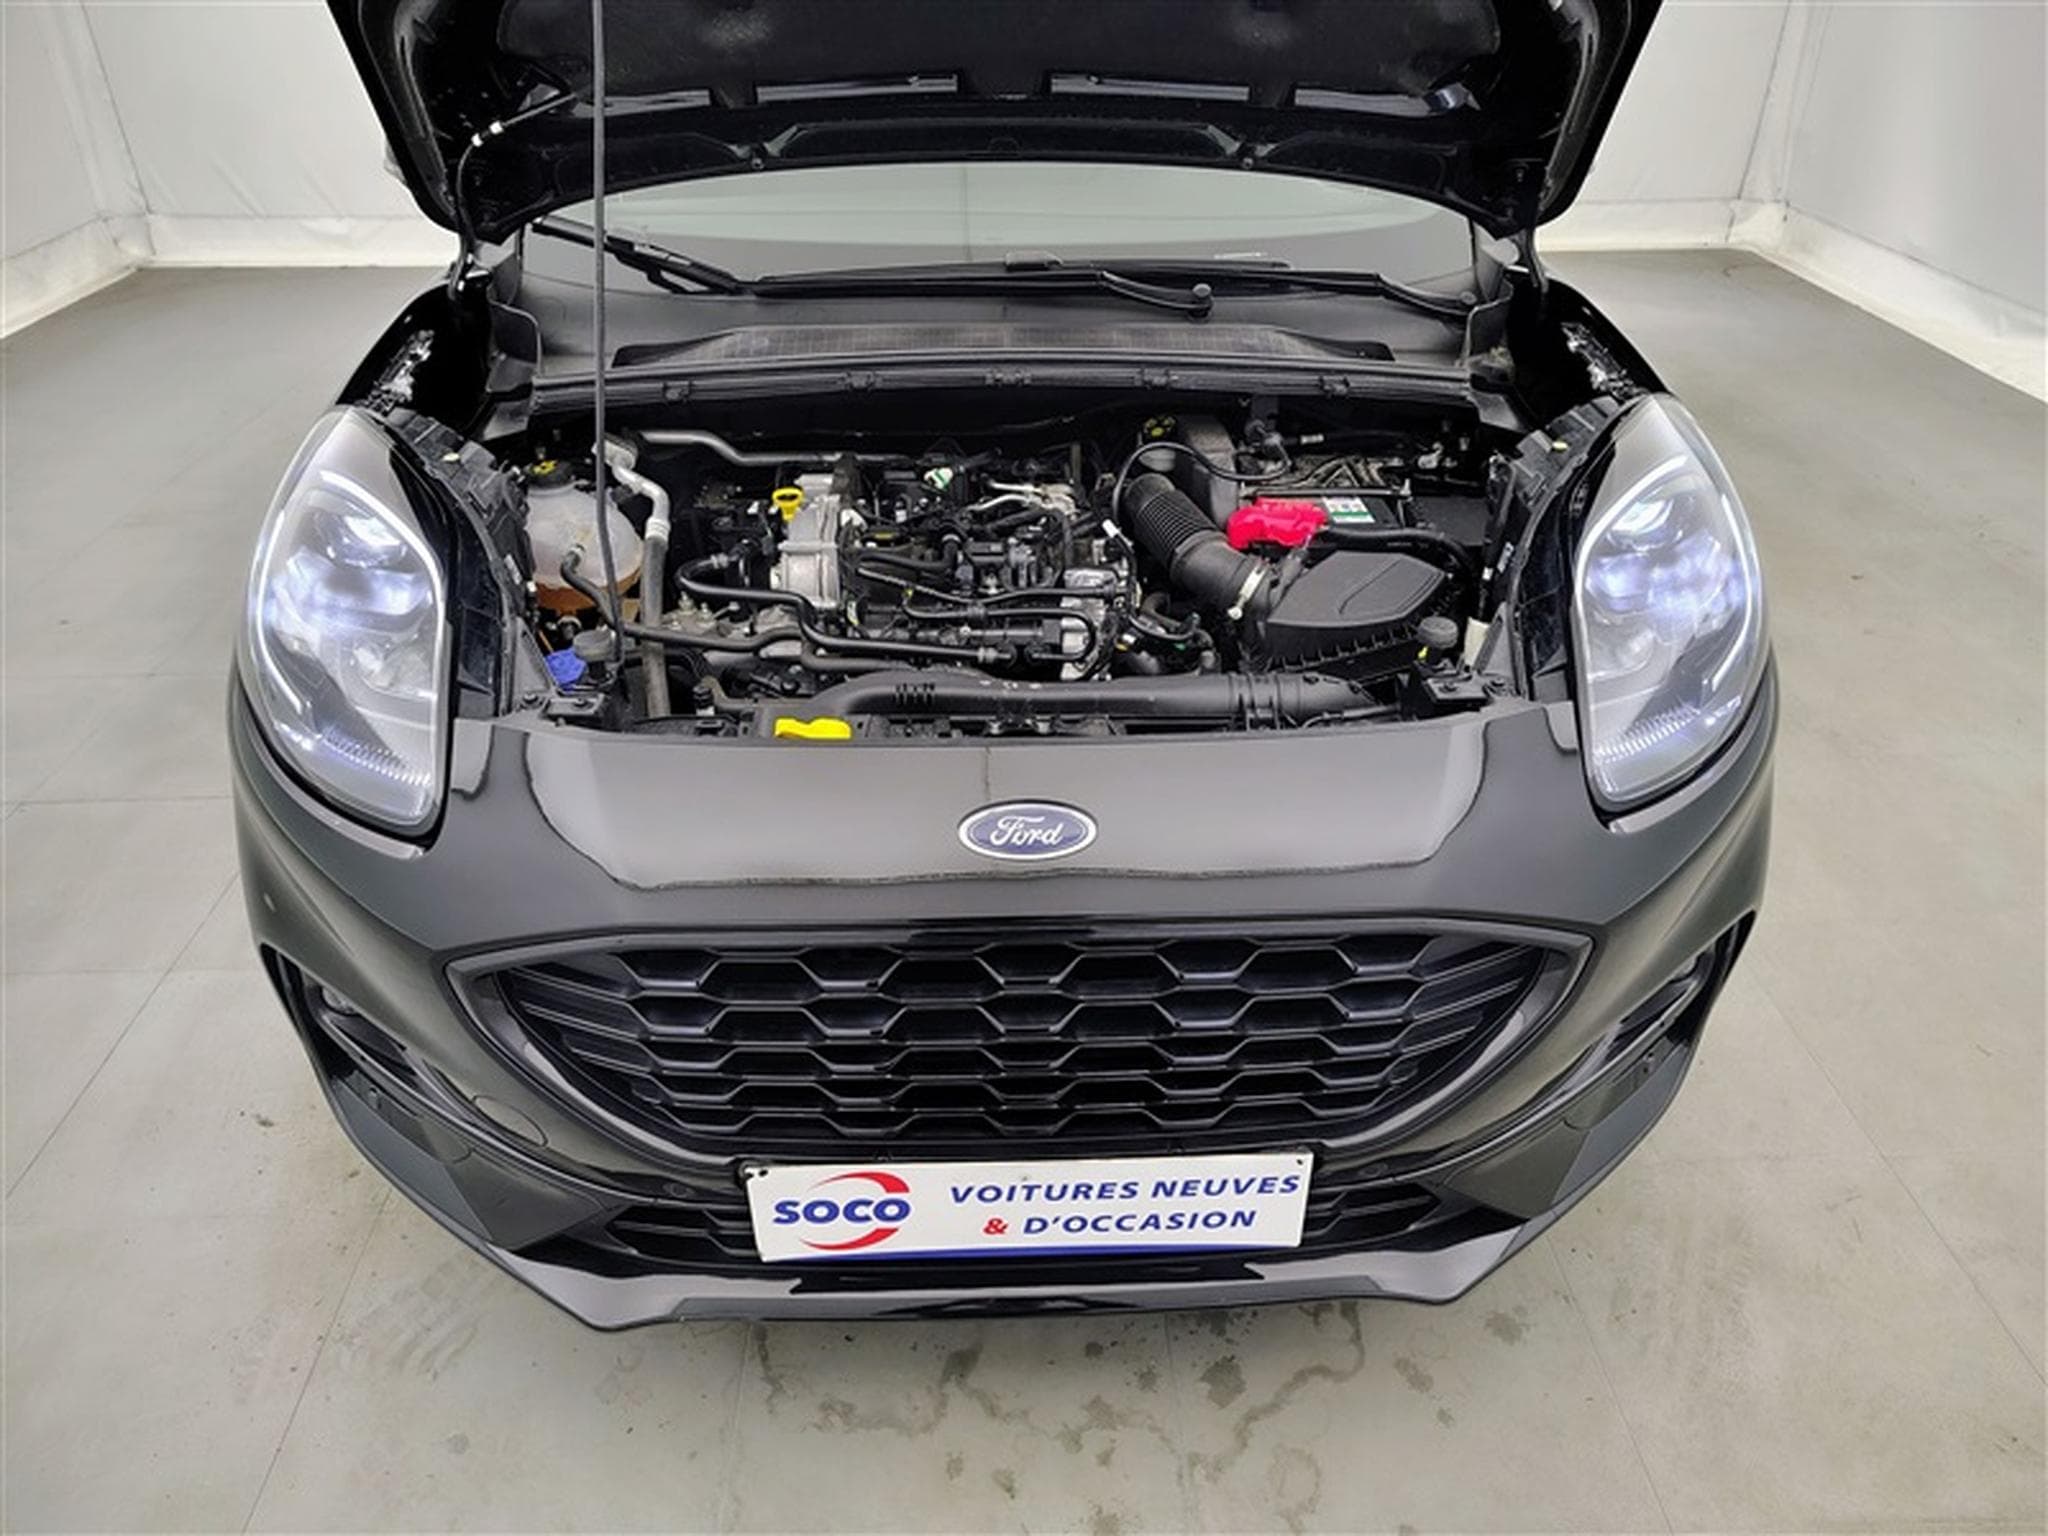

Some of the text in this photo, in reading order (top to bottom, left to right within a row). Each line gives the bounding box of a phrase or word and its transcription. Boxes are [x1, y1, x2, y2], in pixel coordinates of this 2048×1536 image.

[990, 816, 1063, 845] Ford
[950, 1175, 1301, 1203] VOITURES NEUVES
[772, 1199, 911, 1226] SOCO
[982, 1210, 1257, 1236] & D'OCCASION
